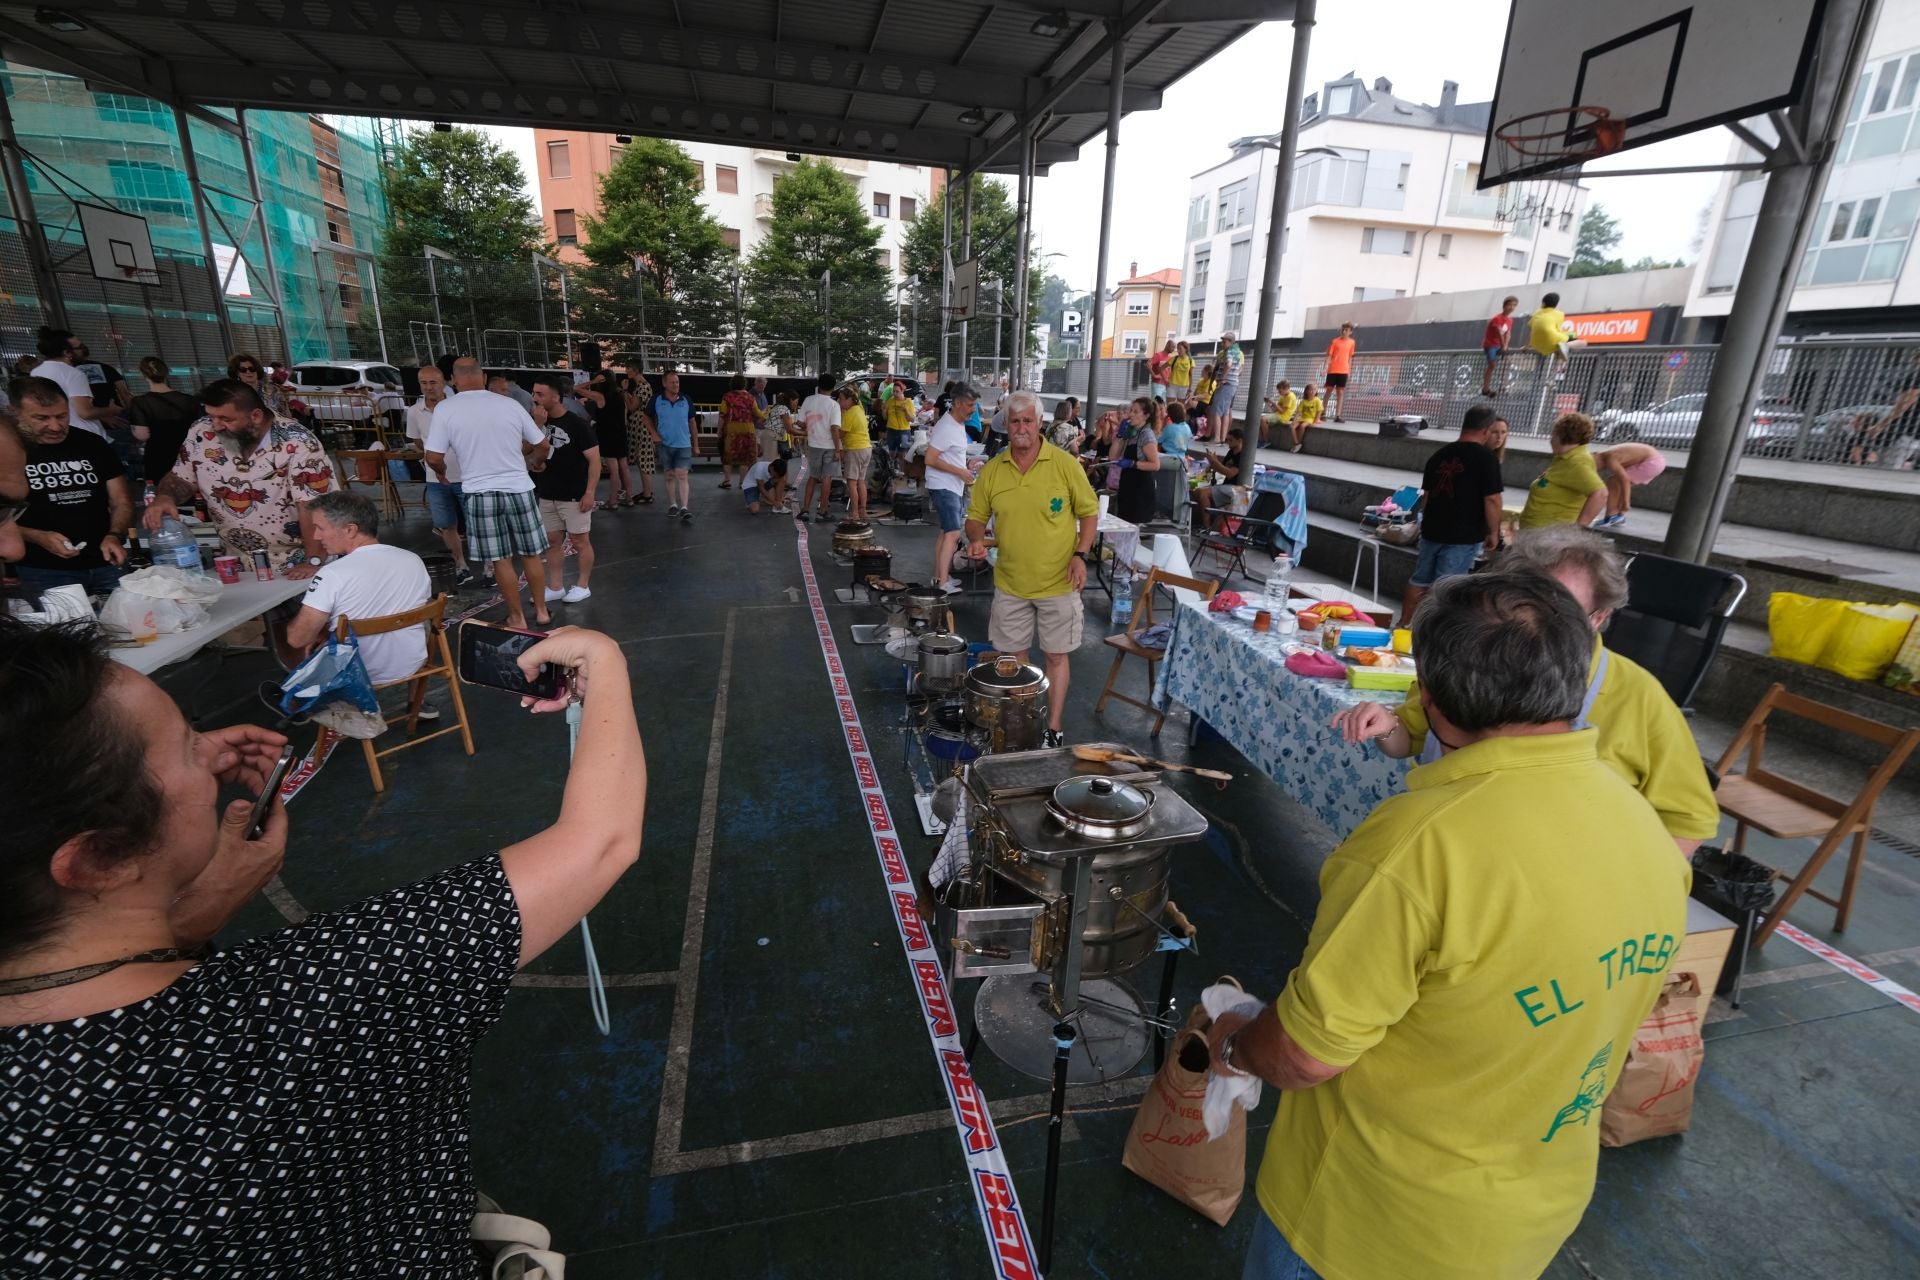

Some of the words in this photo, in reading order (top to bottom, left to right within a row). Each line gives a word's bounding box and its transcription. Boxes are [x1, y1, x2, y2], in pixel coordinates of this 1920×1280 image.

[1063, 311, 1081, 332] P
[1575, 319, 1639, 336] VIVAGYM
[29, 472, 98, 490] 39300
[853, 756, 878, 788] BETA
[864, 792, 893, 831] BETA
[876, 836, 910, 885] BETA
[891, 890, 931, 951] BETA
[911, 959, 958, 1038] BETA
[1514, 979, 1584, 1028] EL
[1598, 933, 1681, 991] TREB
[940, 1048, 997, 1154] BETA
